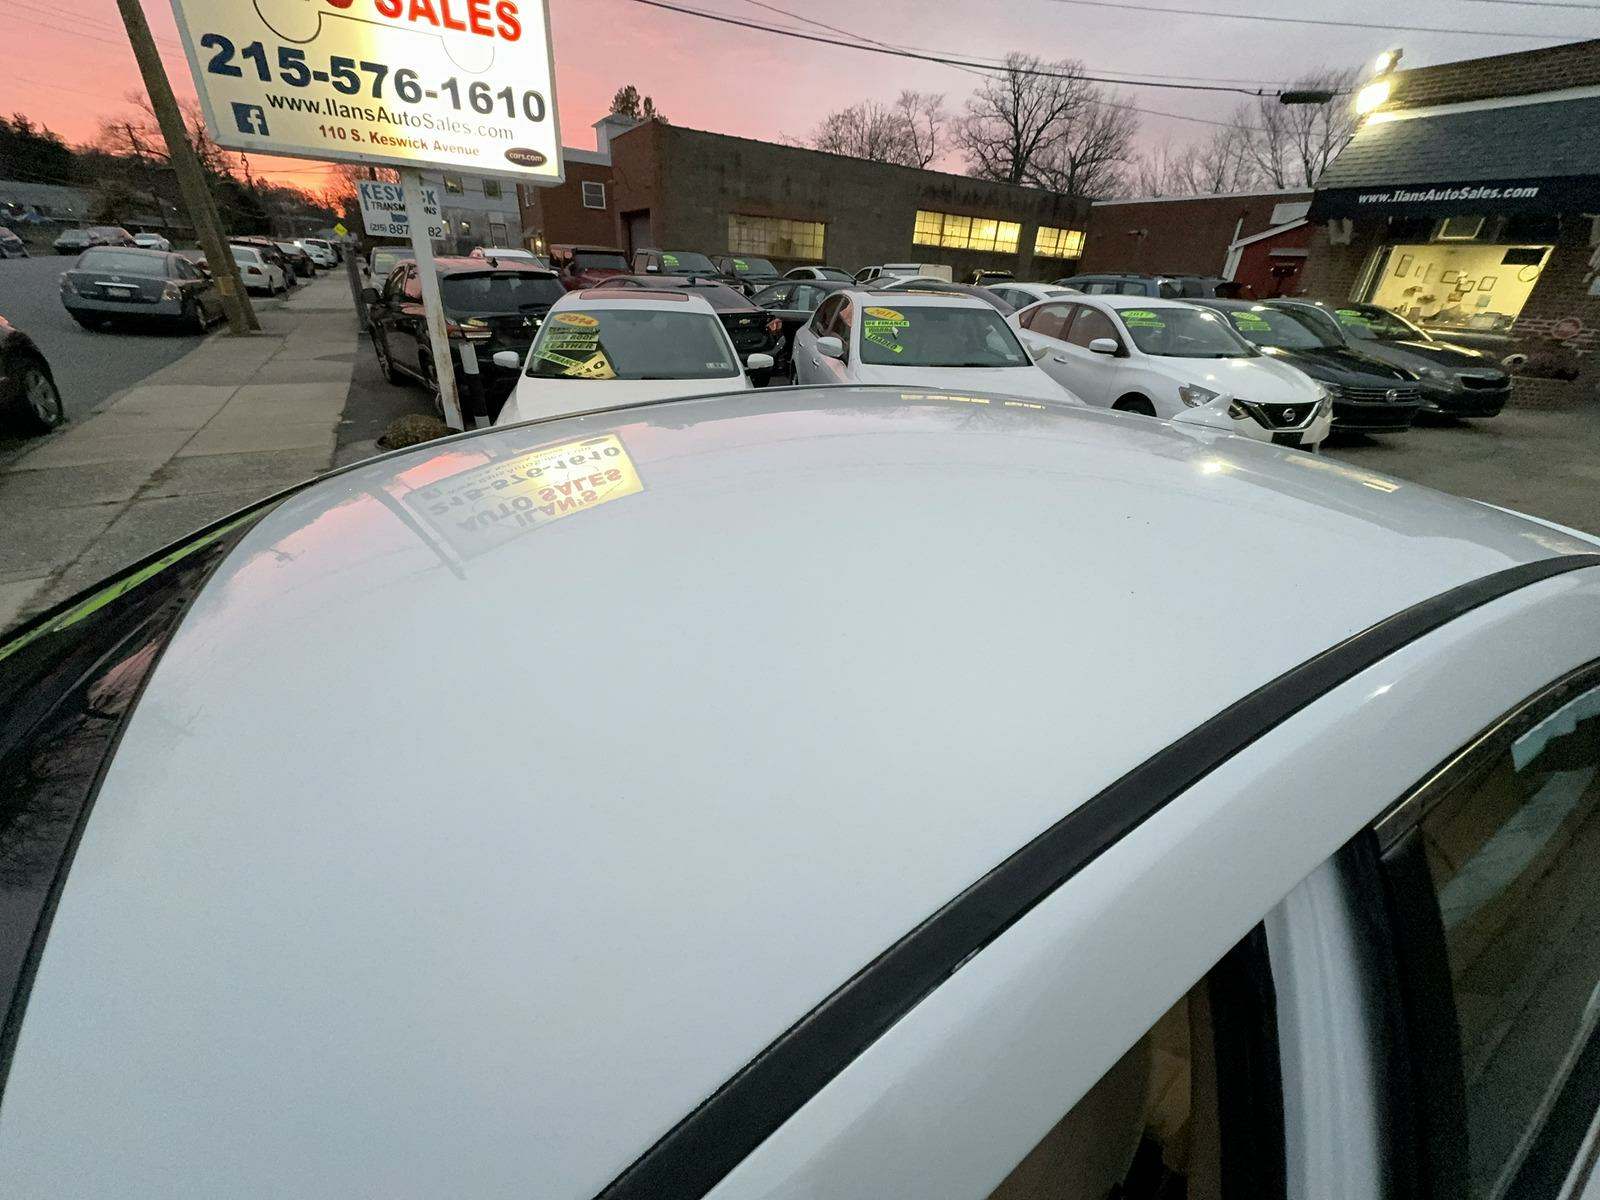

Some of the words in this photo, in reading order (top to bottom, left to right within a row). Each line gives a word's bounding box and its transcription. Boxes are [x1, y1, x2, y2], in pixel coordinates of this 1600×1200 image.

[200, 33, 546, 123] 215-576-1610
[319, 124, 346, 139] 110
[351, 129, 365, 142] S.
[369, 131, 428, 150] Keswick
[433, 141, 480, 156] Avenue
[370, 222, 387, 232] (215)
